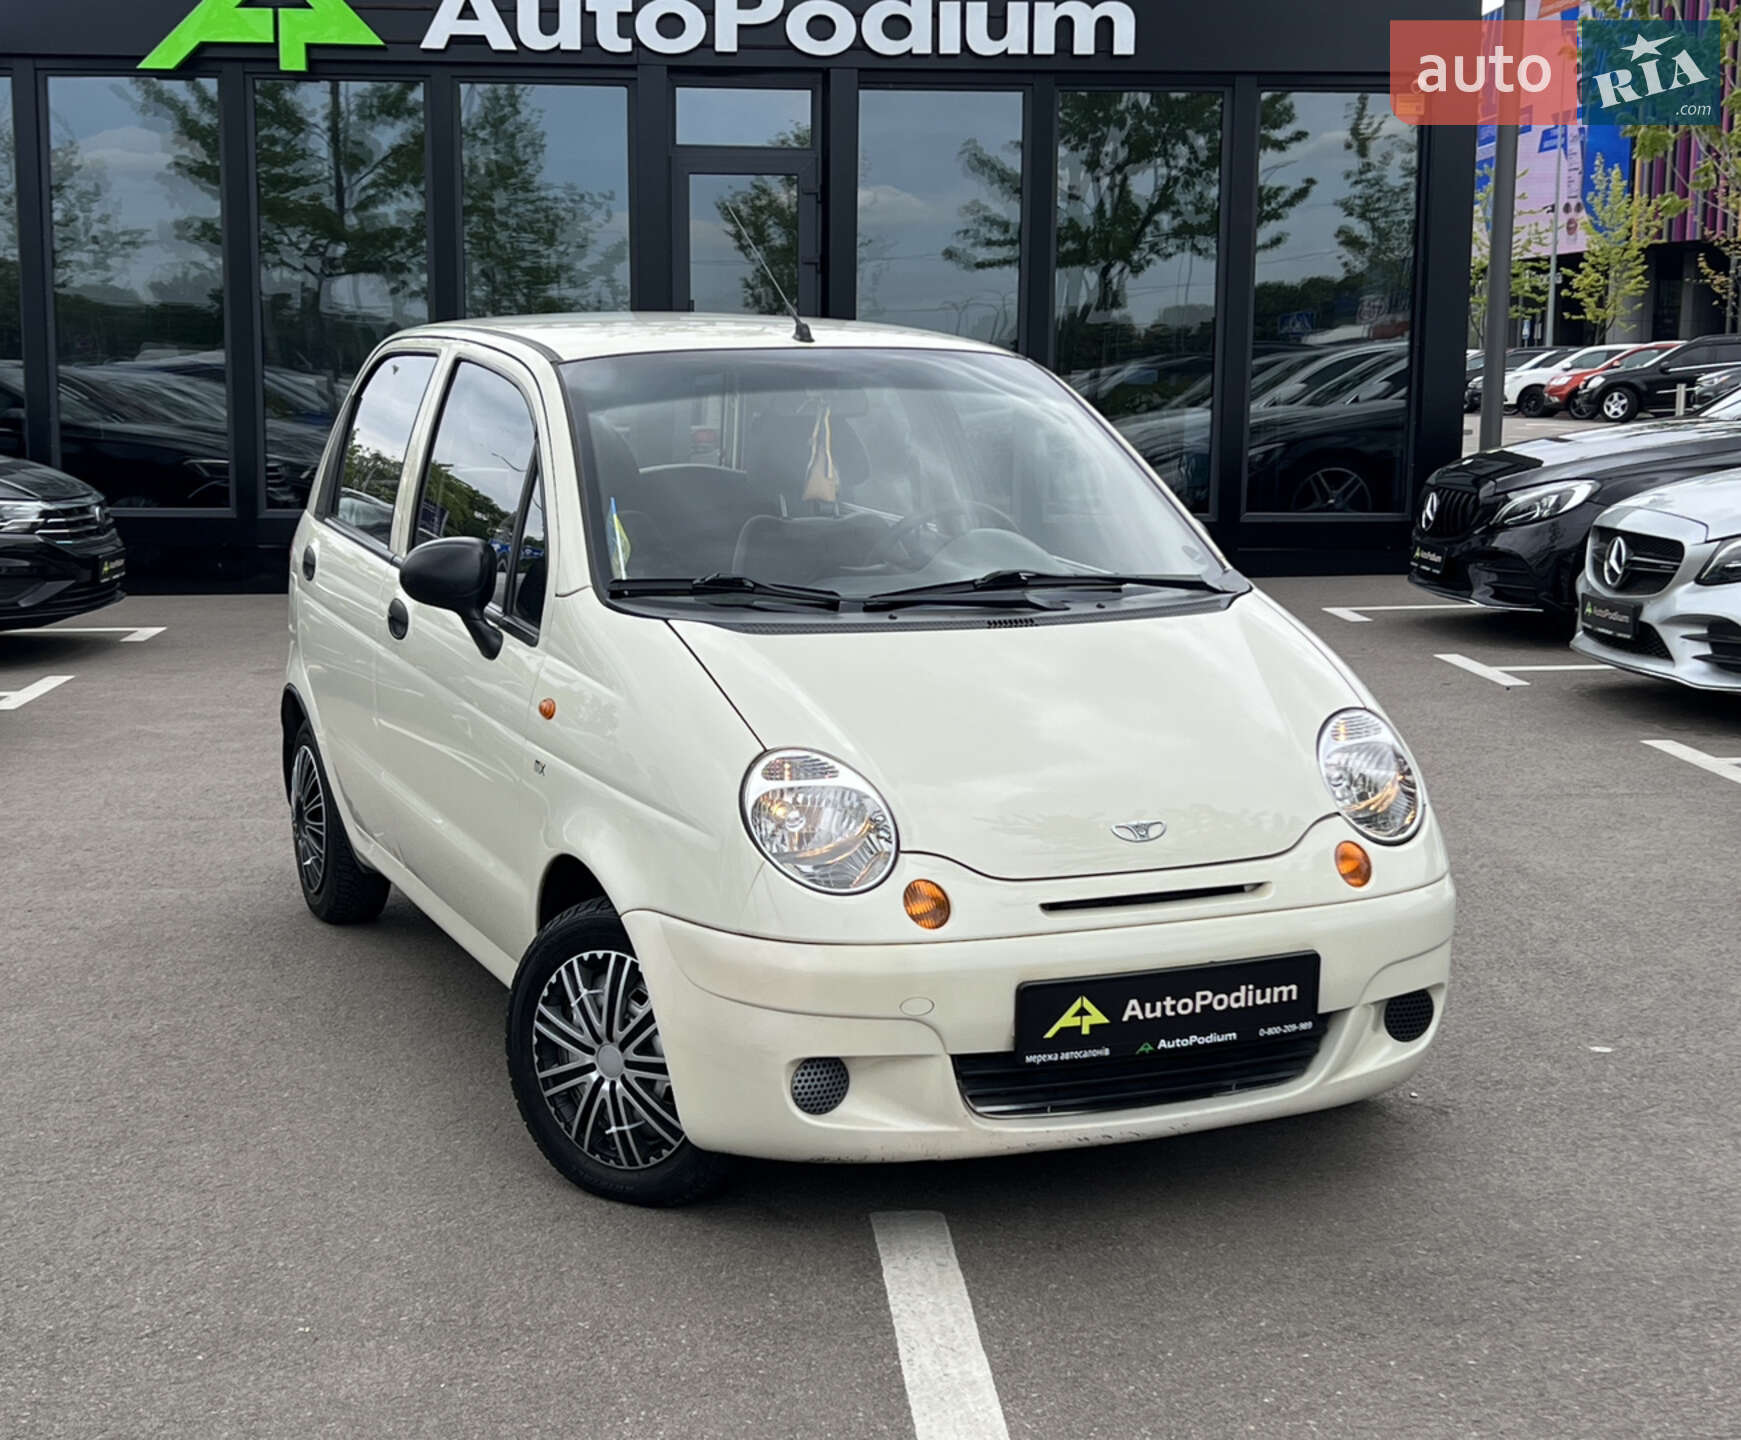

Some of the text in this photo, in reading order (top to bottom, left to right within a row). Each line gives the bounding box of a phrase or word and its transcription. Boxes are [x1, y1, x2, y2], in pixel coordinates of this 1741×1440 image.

[419, 0, 1136, 56] AutoPodium
[1121, 983, 1298, 1022] AutoPodium
[1157, 1031, 1238, 1050] AutoPodium
